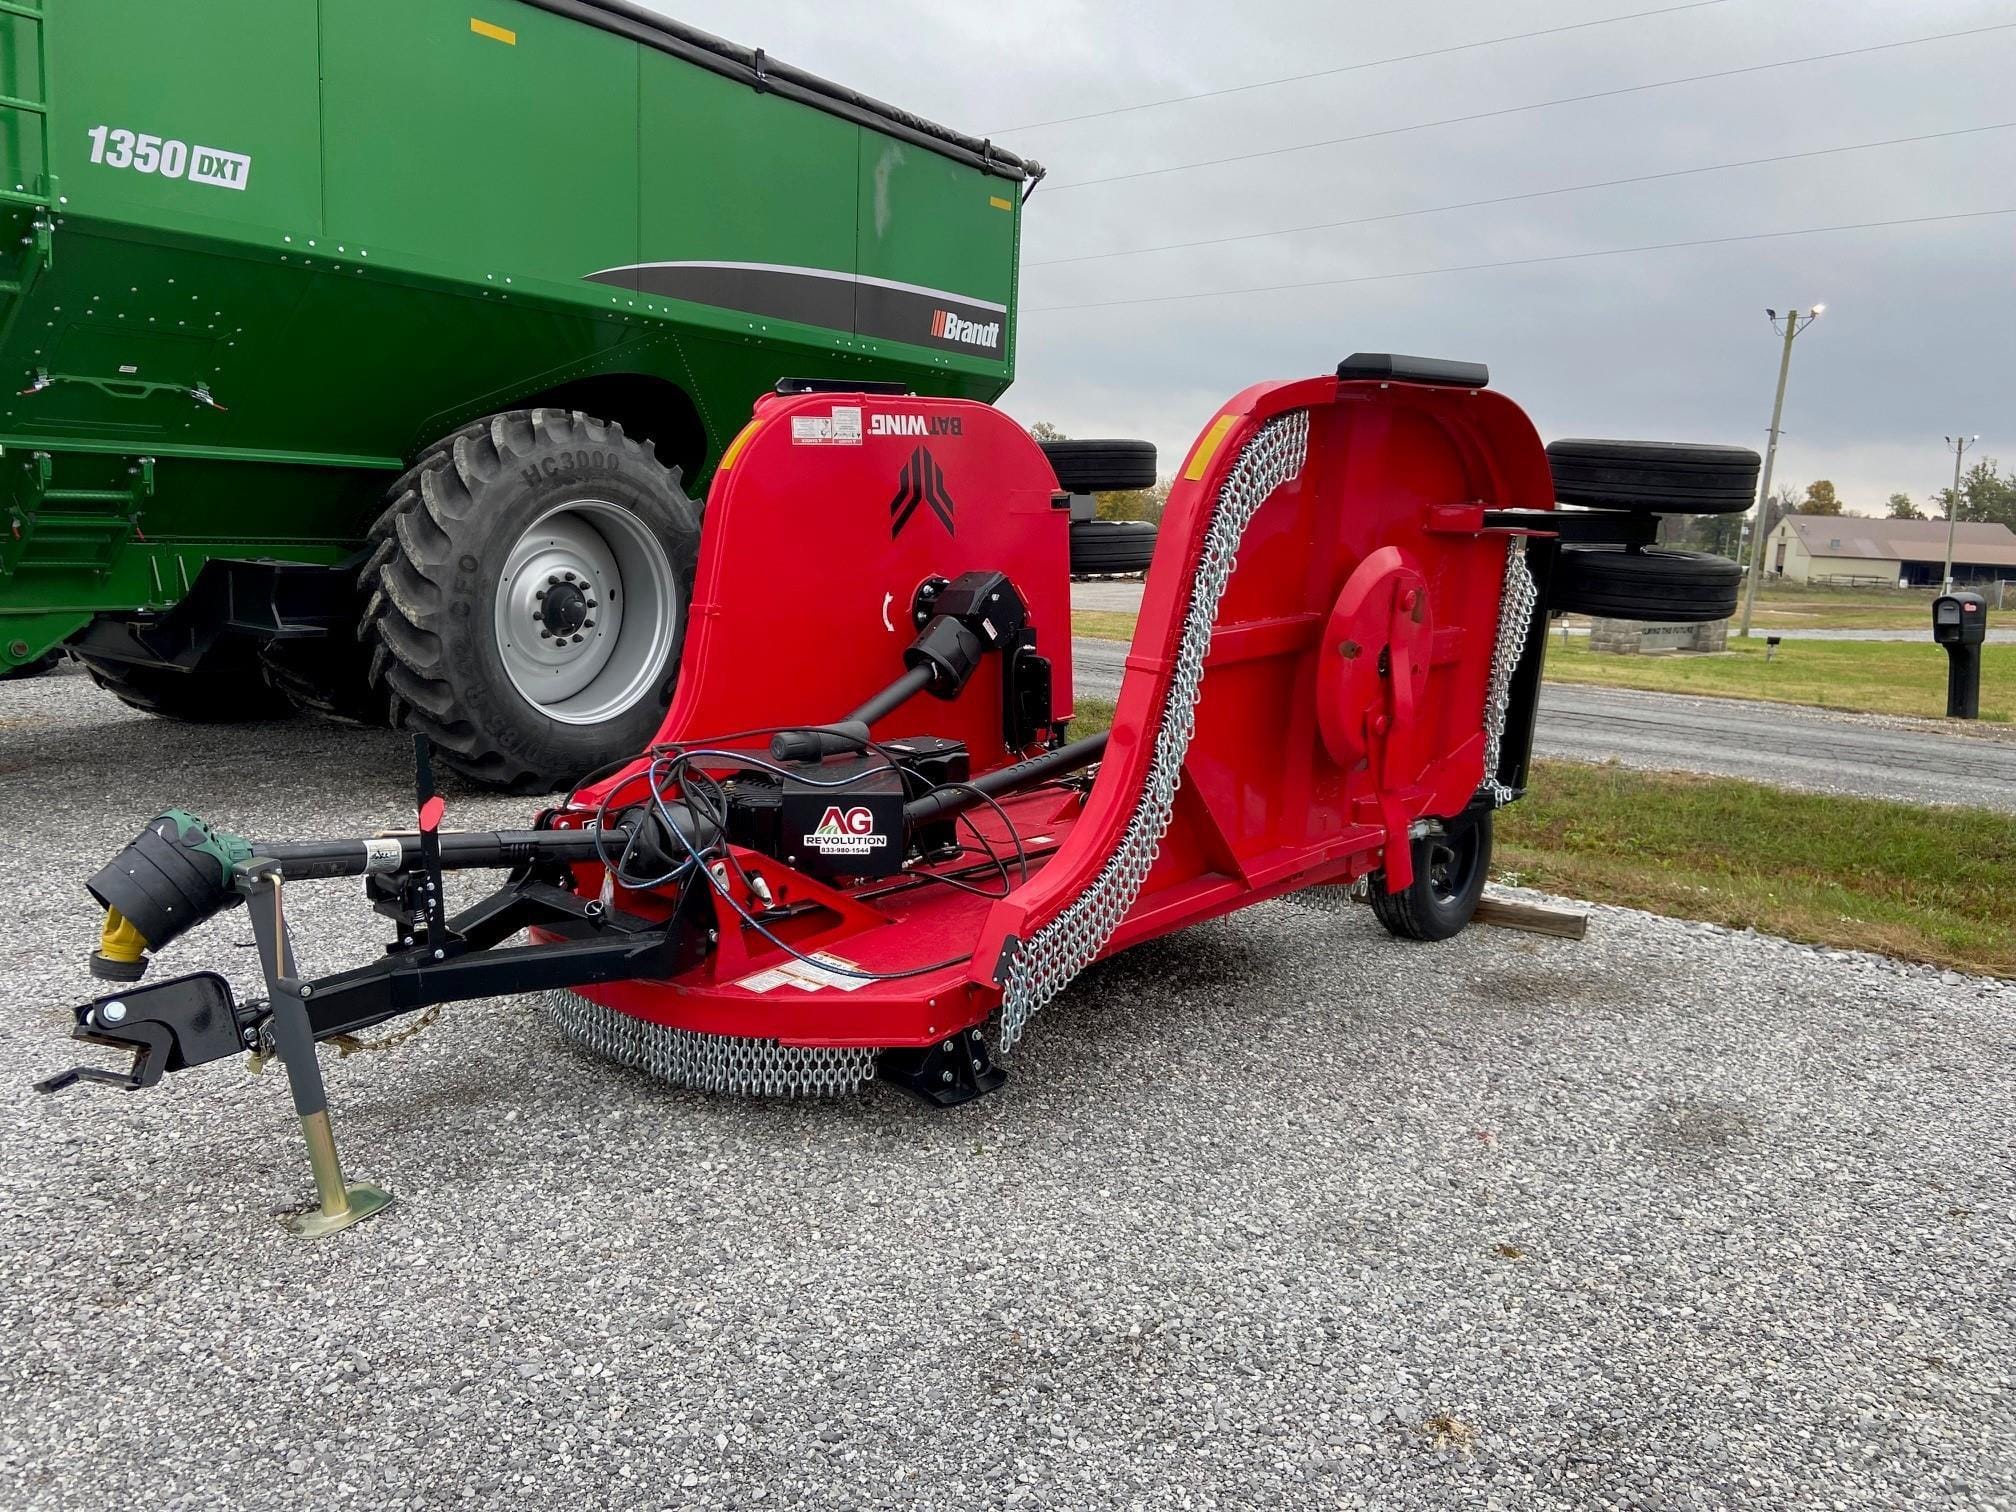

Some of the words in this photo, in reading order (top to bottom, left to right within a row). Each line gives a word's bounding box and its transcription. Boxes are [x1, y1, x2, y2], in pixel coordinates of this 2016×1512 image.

[88, 125, 188, 179] 1350
[197, 154, 243, 182] DXT
[943, 312, 1000, 348] Brandt
[521, 450, 620, 488] HC3000
[816, 808, 872, 835] AG
[806, 836, 886, 845] REVOLUTION
